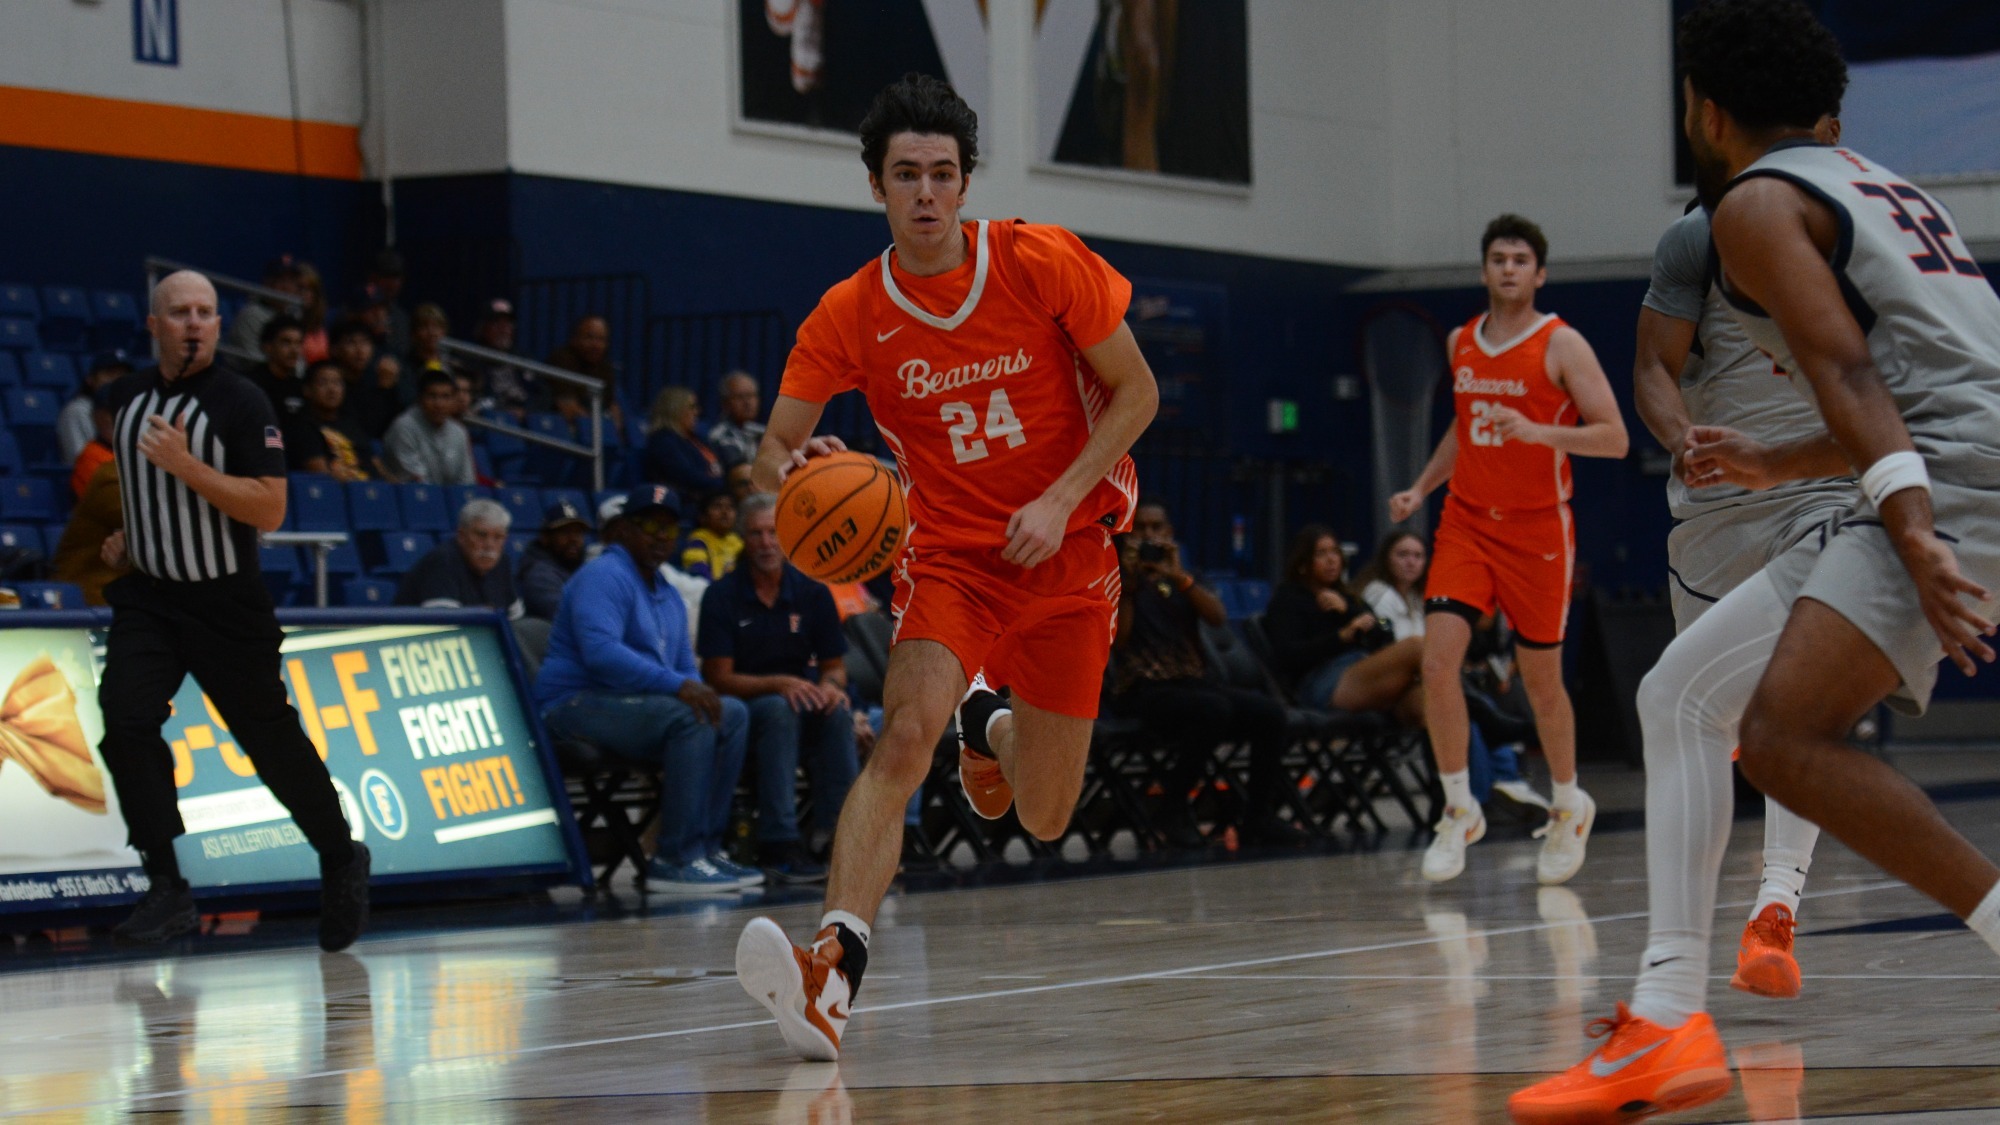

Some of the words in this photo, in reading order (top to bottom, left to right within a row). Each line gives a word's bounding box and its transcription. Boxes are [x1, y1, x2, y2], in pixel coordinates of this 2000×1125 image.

[141, 0, 170, 60] N
[1851, 182, 1986, 278] 32
[897, 348, 1032, 399] Beavers
[1454, 366, 1528, 397] Beavers
[940, 388, 1026, 465] 24
[379, 635, 483, 699] FIGHT!
[398, 694, 505, 760] FIGHT!
[420, 754, 526, 820] FIGHT!
